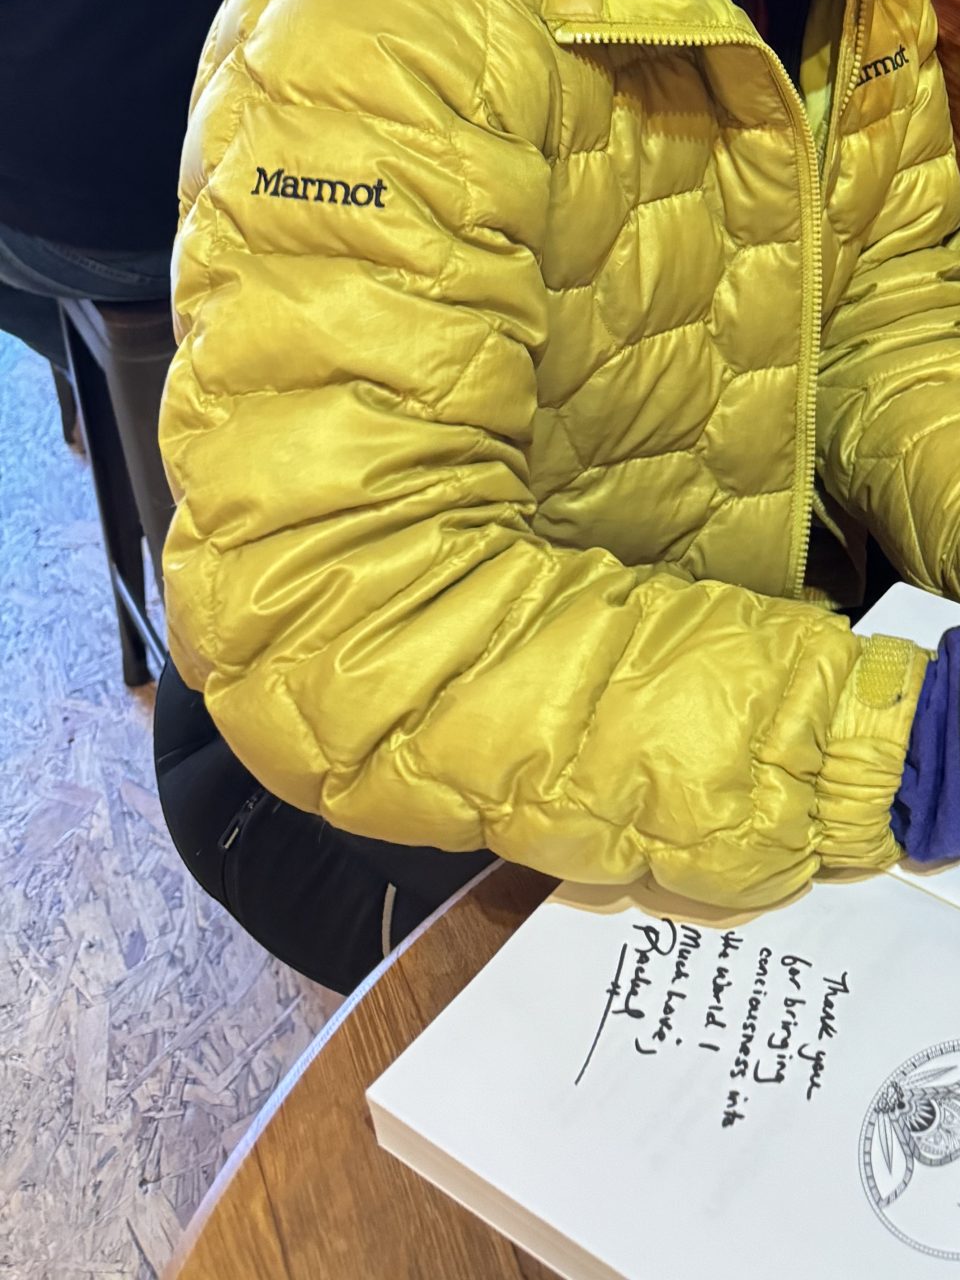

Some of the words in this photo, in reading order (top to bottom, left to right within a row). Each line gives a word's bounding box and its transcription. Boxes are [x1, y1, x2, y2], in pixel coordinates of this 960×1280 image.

[251, 166, 387, 208] Marmot
[718, 930, 745, 960] the
[780, 954, 813, 991] for
[817, 970, 851, 1041] Thank
[752, 996, 807, 1085] bringing
[796, 1043, 827, 1101] you
